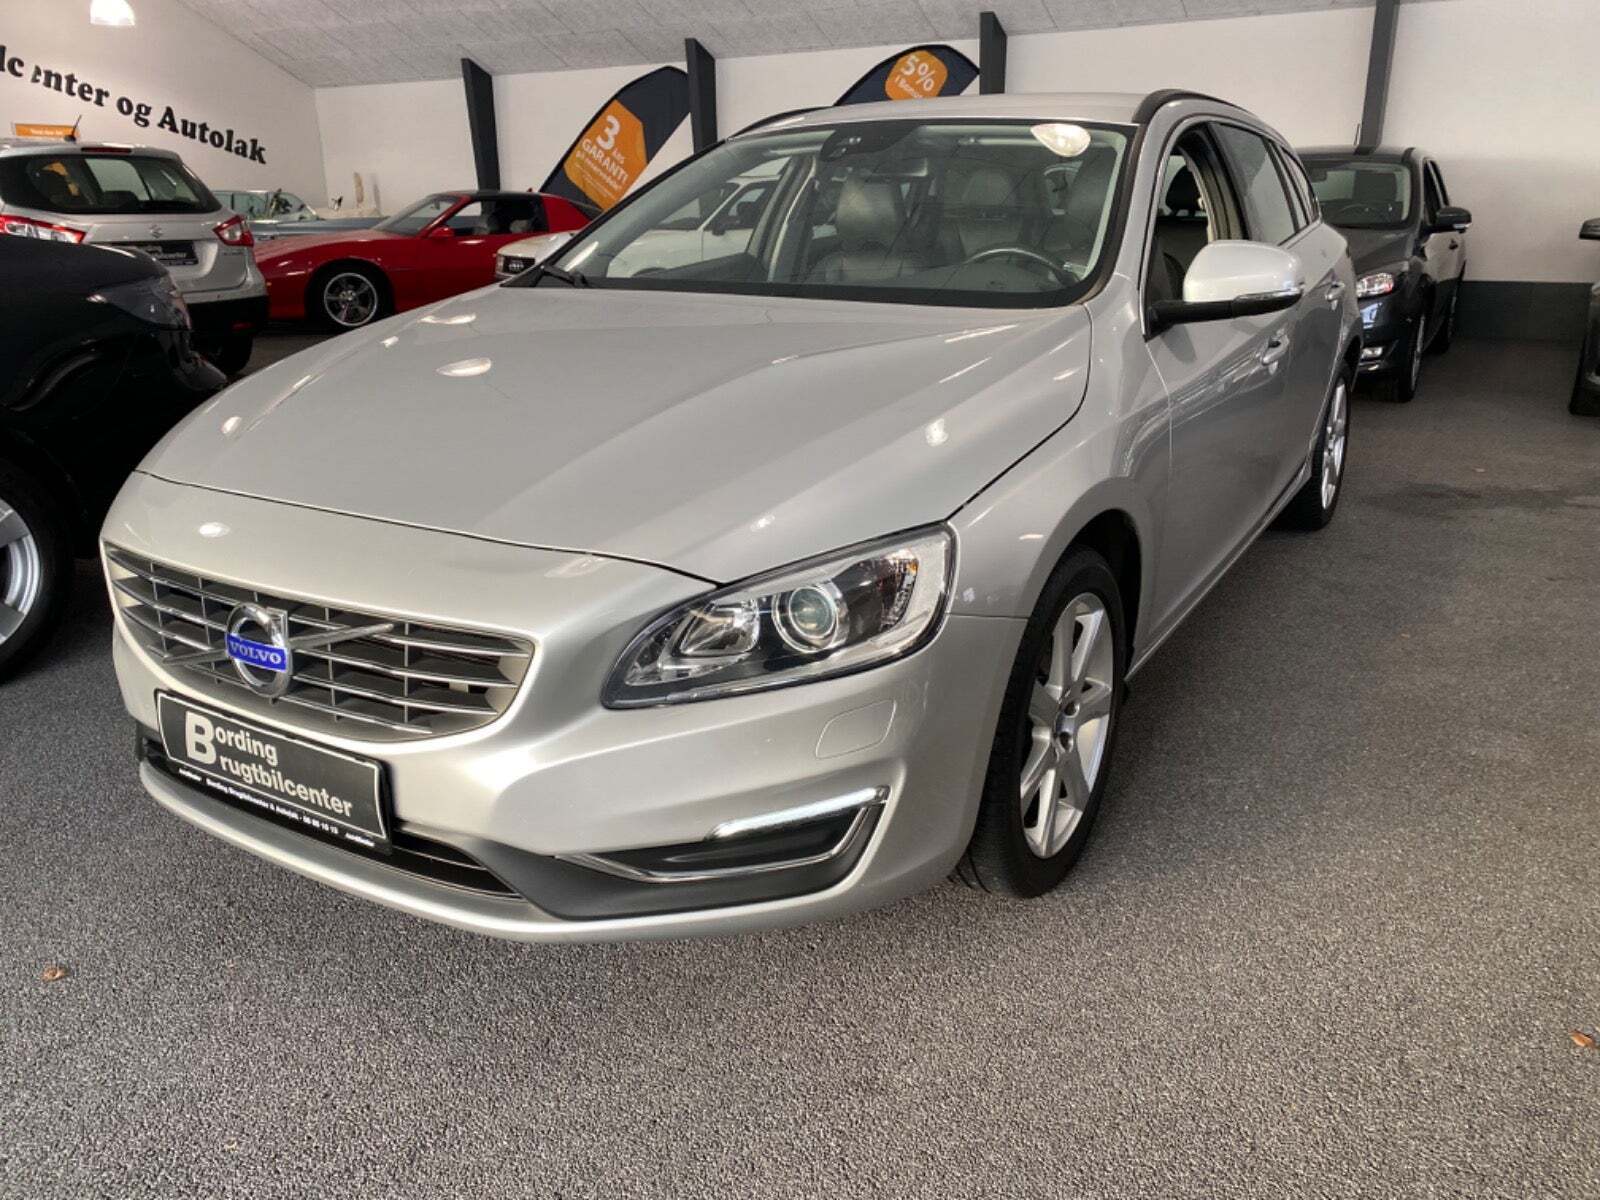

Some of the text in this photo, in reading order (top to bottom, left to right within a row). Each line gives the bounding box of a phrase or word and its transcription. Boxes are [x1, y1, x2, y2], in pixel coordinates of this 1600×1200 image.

[900, 54, 935, 92] 5%
[116, 96, 152, 128] og
[157, 105, 267, 164] Autolak
[596, 114, 621, 150] 3
[582, 138, 630, 185] GARANTI
[229, 639, 282, 664] VOLVO
